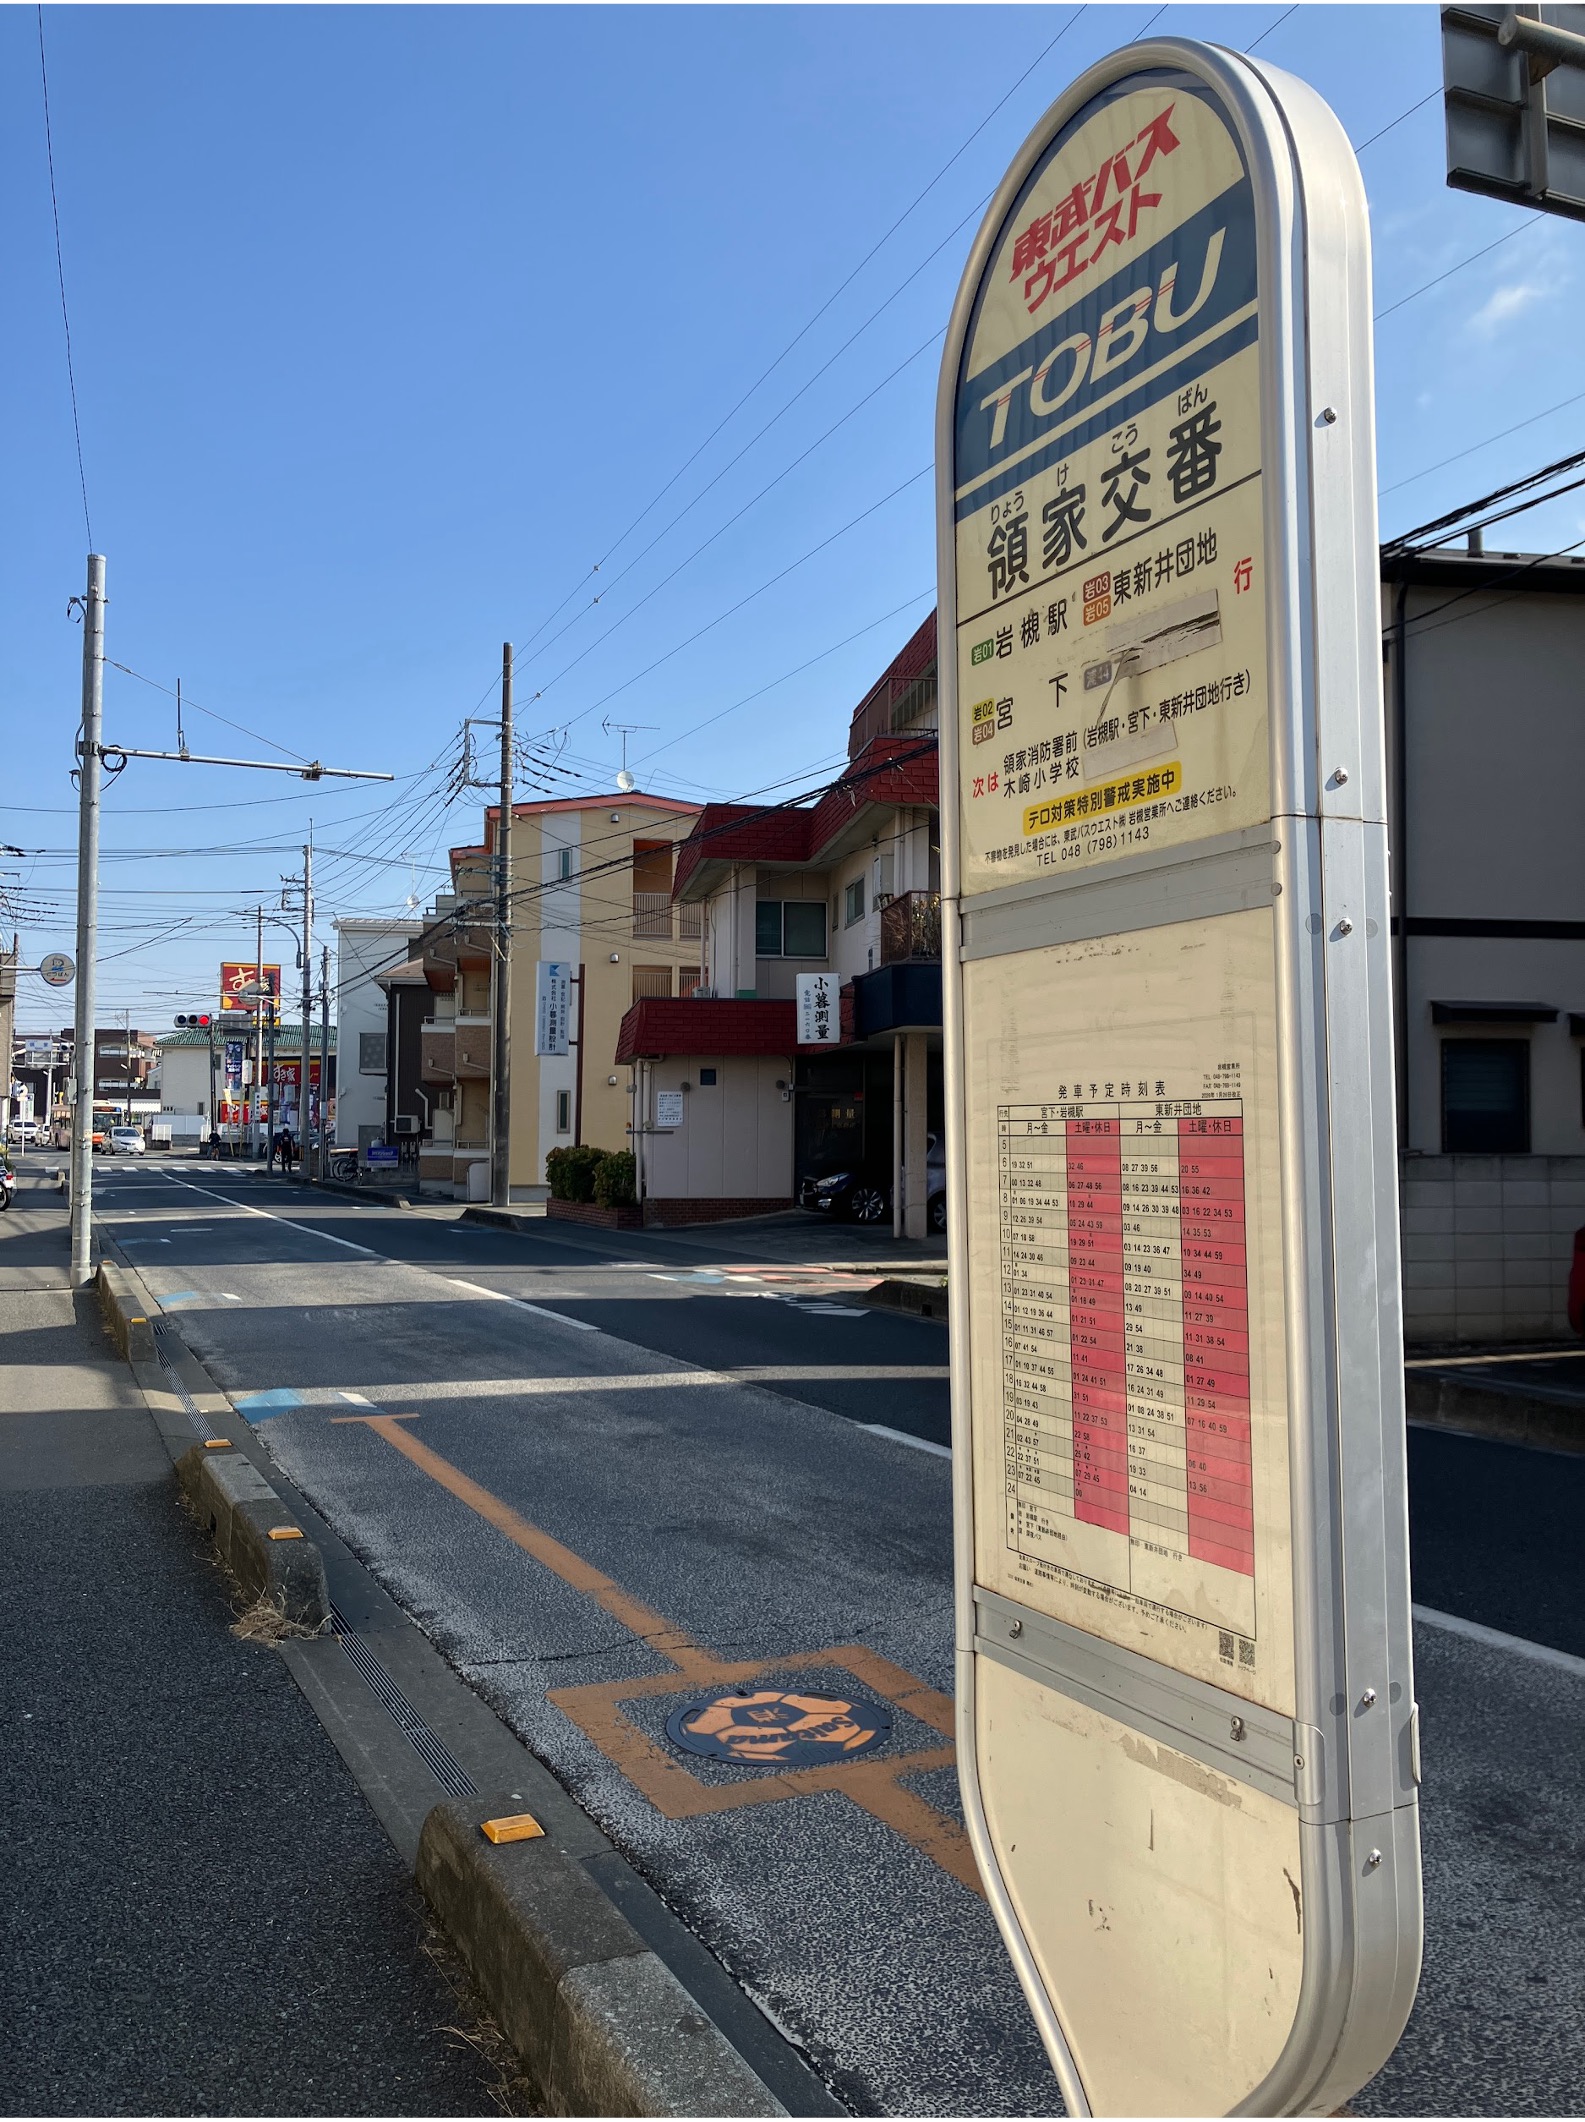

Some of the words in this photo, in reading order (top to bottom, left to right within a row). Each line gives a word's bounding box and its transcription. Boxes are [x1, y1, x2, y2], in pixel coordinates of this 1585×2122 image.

[1009, 102, 1181, 283] 東武バス
[1023, 182, 1163, 314] ウエスト
[980, 227, 1226, 450] TOBU
[990, 491, 1024, 524] りょう
[1057, 464, 1069, 486] け
[1111, 423, 1138, 453] こう
[1177, 384, 1207, 416] ばん
[987, 401, 1222, 600] 領家交番
[1085, 575, 1110, 600] 岩03
[1113, 527, 1218, 606] 東新井団地
[1234, 557, 1252, 593] 行
[1085, 595, 1110, 621] 岩05
[973, 642, 993, 662] 岩01
[995, 598, 1068, 659] 岩槻駅
[973, 701, 993, 721] 岩02
[973, 724, 994, 742] 岩04
[1003, 731, 1078, 774] 領家消防署前
[1003, 757, 1080, 799] 木崎小学校
[973, 772, 999, 798] 次は
[1028, 769, 1175, 829] テロ対策特別警戒実施中
[1036, 851, 1057, 867] TEL
[1061, 844, 1081, 861] 048
[814, 977, 831, 1040] 小暮測量
[1058, 1080, 1165, 1099] 発車予定時刻表
[1040, 1106, 1084, 1118] 宮下・岩槻駅
[1155, 1102, 1202, 1116] 東新井団地
[1074, 1122, 1110, 1134] 土曜・休日
[1188, 1120, 1232, 1134] 土曜・休日
[1002, 1139, 1006, 1148] 5
[1002, 1157, 1006, 1166] 6
[1003, 1175, 1006, 1184] 7
[1170, 1185, 1178, 1193] 53
[1182, 1186, 1188, 1194] 16
[1191, 1186, 1199, 1194] 36
[1202, 1186, 1209, 1195] 42
[1003, 1193, 1007, 1202] 8
[1003, 1211, 1007, 1220] 9
[1161, 1205, 1168, 1213] 39
[1171, 1205, 1178, 1214] 48
[1182, 1206, 1189, 1214] 03
[1192, 1207, 1199, 1215] 16
[1202, 1207, 1210, 1216] 22
[1213, 1208, 1221, 1216] 34
[1224, 1208, 1232, 1217] 53
[1002, 1229, 1010, 1238] 10
[1183, 1227, 1189, 1235] 14
[1192, 1228, 1200, 1236] 35
[1203, 1229, 1210, 1237] 53
[1003, 1247, 1010, 1256] 11
[1123, 1242, 1130, 1250] 03
[1133, 1243, 1139, 1251] 14
[1142, 1244, 1149, 1252] 23
[1152, 1245, 1159, 1253] 36
[1162, 1246, 1169, 1254] 47
[1183, 1248, 1190, 1256] 10
[1193, 1249, 1200, 1257] 34
[1204, 1250, 1211, 1258] 44
[1214, 1251, 1222, 1259] 59
[1003, 1265, 1010, 1275] 12
[1003, 1283, 1011, 1293] 13
[1124, 1282, 1131, 1291] 08
[1134, 1284, 1140, 1292] 20
[1143, 1285, 1150, 1293] 27
[1153, 1286, 1160, 1294] 39
[1163, 1287, 1169, 1295] 51
[1004, 1301, 1011, 1311] 14
[1185, 1310, 1191, 1319] 11
[1195, 1312, 1202, 1321] 27
[1205, 1313, 1213, 1322] 39
[1004, 1319, 1012, 1329] 15
[1004, 1337, 1012, 1347] 16
[1005, 1355, 1012, 1365] 17
[1127, 1363, 1133, 1371] 17
[1136, 1364, 1142, 1373] 26
[1145, 1366, 1152, 1375] 34
[1155, 1368, 1162, 1377] 48
[1005, 1373, 1013, 1384] 18
[1186, 1374, 1192, 1383] 01
[1196, 1376, 1204, 1385] 27
[1207, 1378, 1214, 1387] 49
[1006, 1391, 1013, 1402] 19
[1127, 1383, 1133, 1392] 16
[1136, 1385, 1143, 1394] 24
[1146, 1387, 1152, 1395] 31
[1156, 1389, 1162, 1398] 49
[1006, 1409, 1013, 1420] 20
[1006, 1427, 1014, 1438] 21
[1128, 1423, 1134, 1432] 13
[1137, 1425, 1143, 1434] 31
[1147, 1428, 1154, 1437] 54
[1007, 1445, 1014, 1457] 22
[1007, 1463, 1014, 1475] 23
[1008, 1482, 1015, 1493] 24
[1129, 1484, 1136, 1493] 04
[1139, 1487, 1145, 1496] 14
[726, 1716, 856, 1745] Saitama
